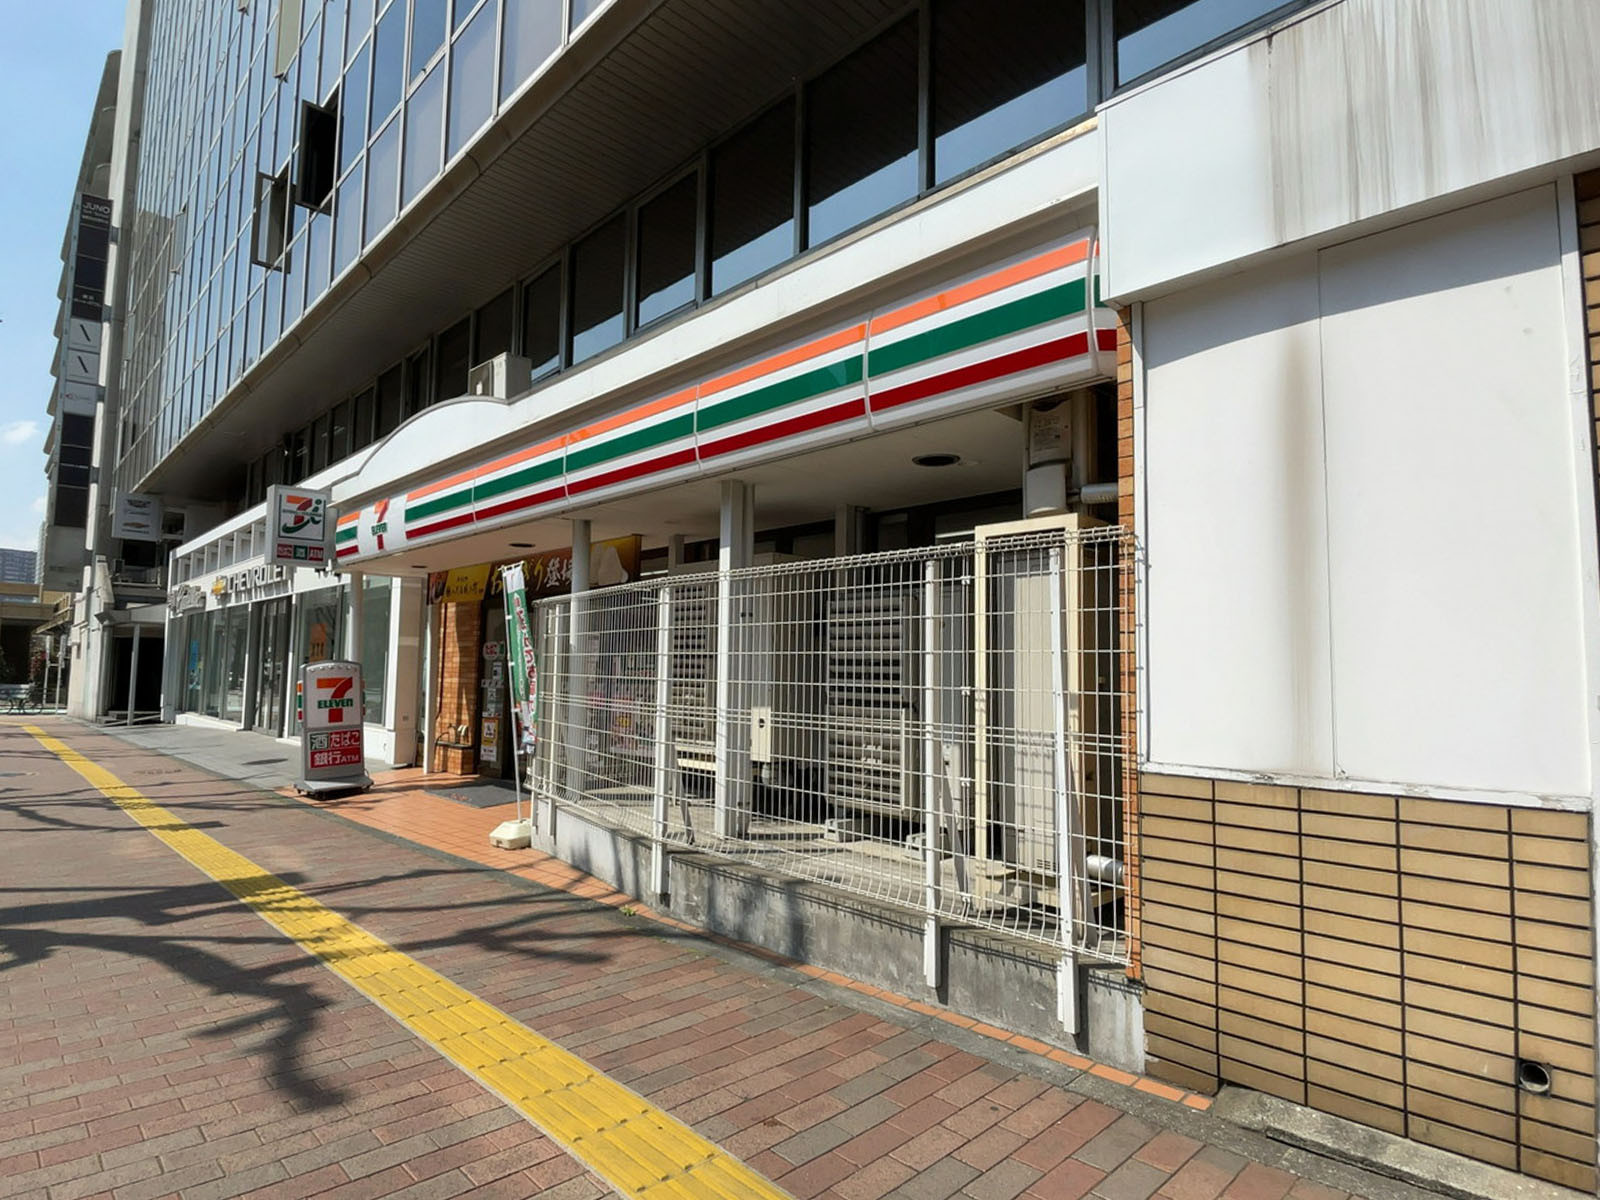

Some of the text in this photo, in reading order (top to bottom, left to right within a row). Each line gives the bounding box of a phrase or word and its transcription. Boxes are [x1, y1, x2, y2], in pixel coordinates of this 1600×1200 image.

[82, 202, 110, 214] JUNO
[374, 497, 390, 551] 7
[227, 564, 287, 593] CHEVROLET
[316, 677, 353, 723] 7
[311, 731, 360, 750] 酒 たばこ
